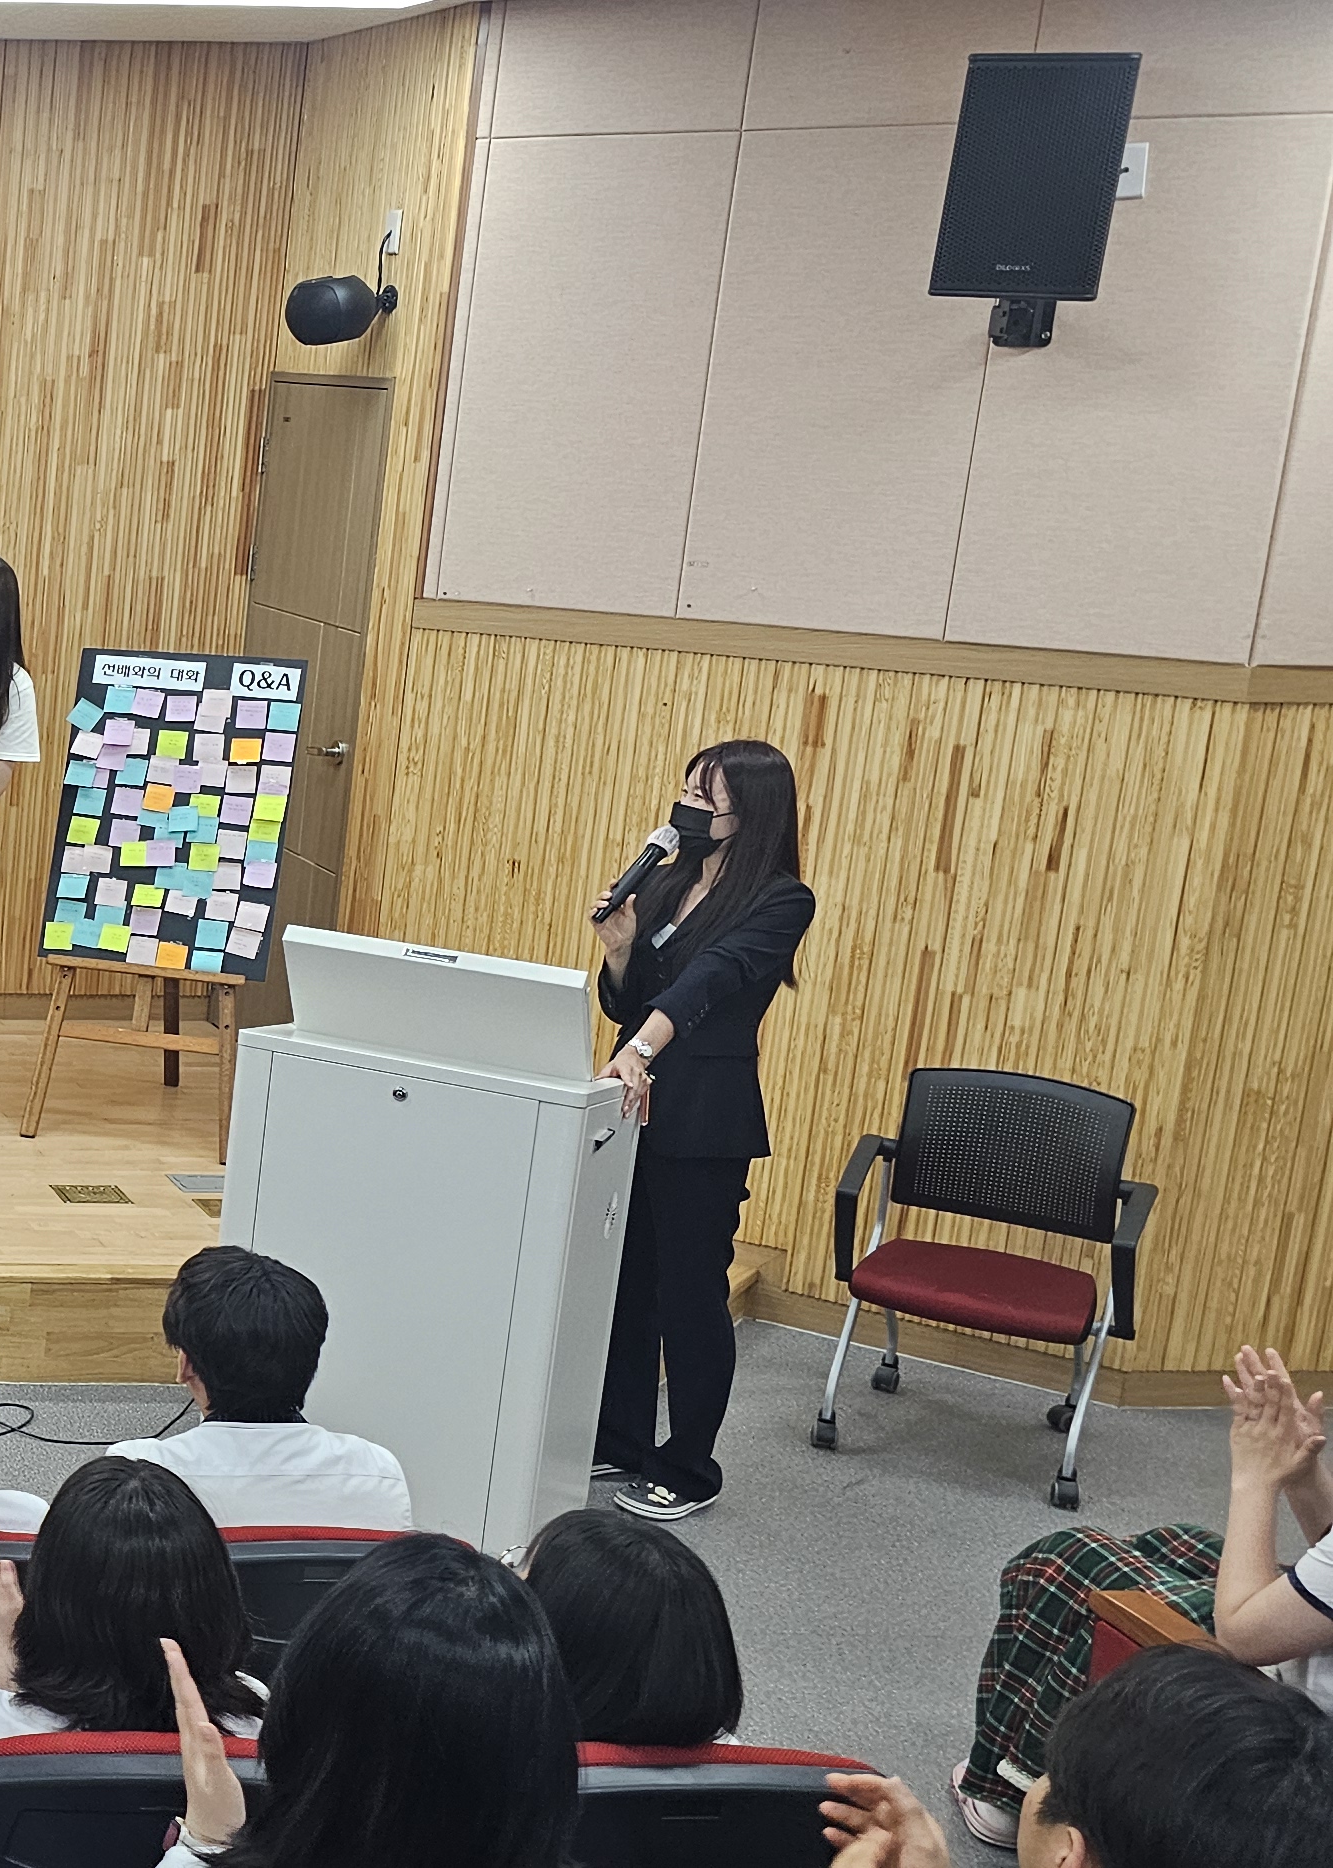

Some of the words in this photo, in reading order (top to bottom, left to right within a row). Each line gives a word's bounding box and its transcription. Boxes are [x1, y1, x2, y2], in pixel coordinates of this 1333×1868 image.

[101, 663, 162, 680] 선배와의
[169, 668, 201, 683] 대화
[238, 669, 292, 692] Q&A
